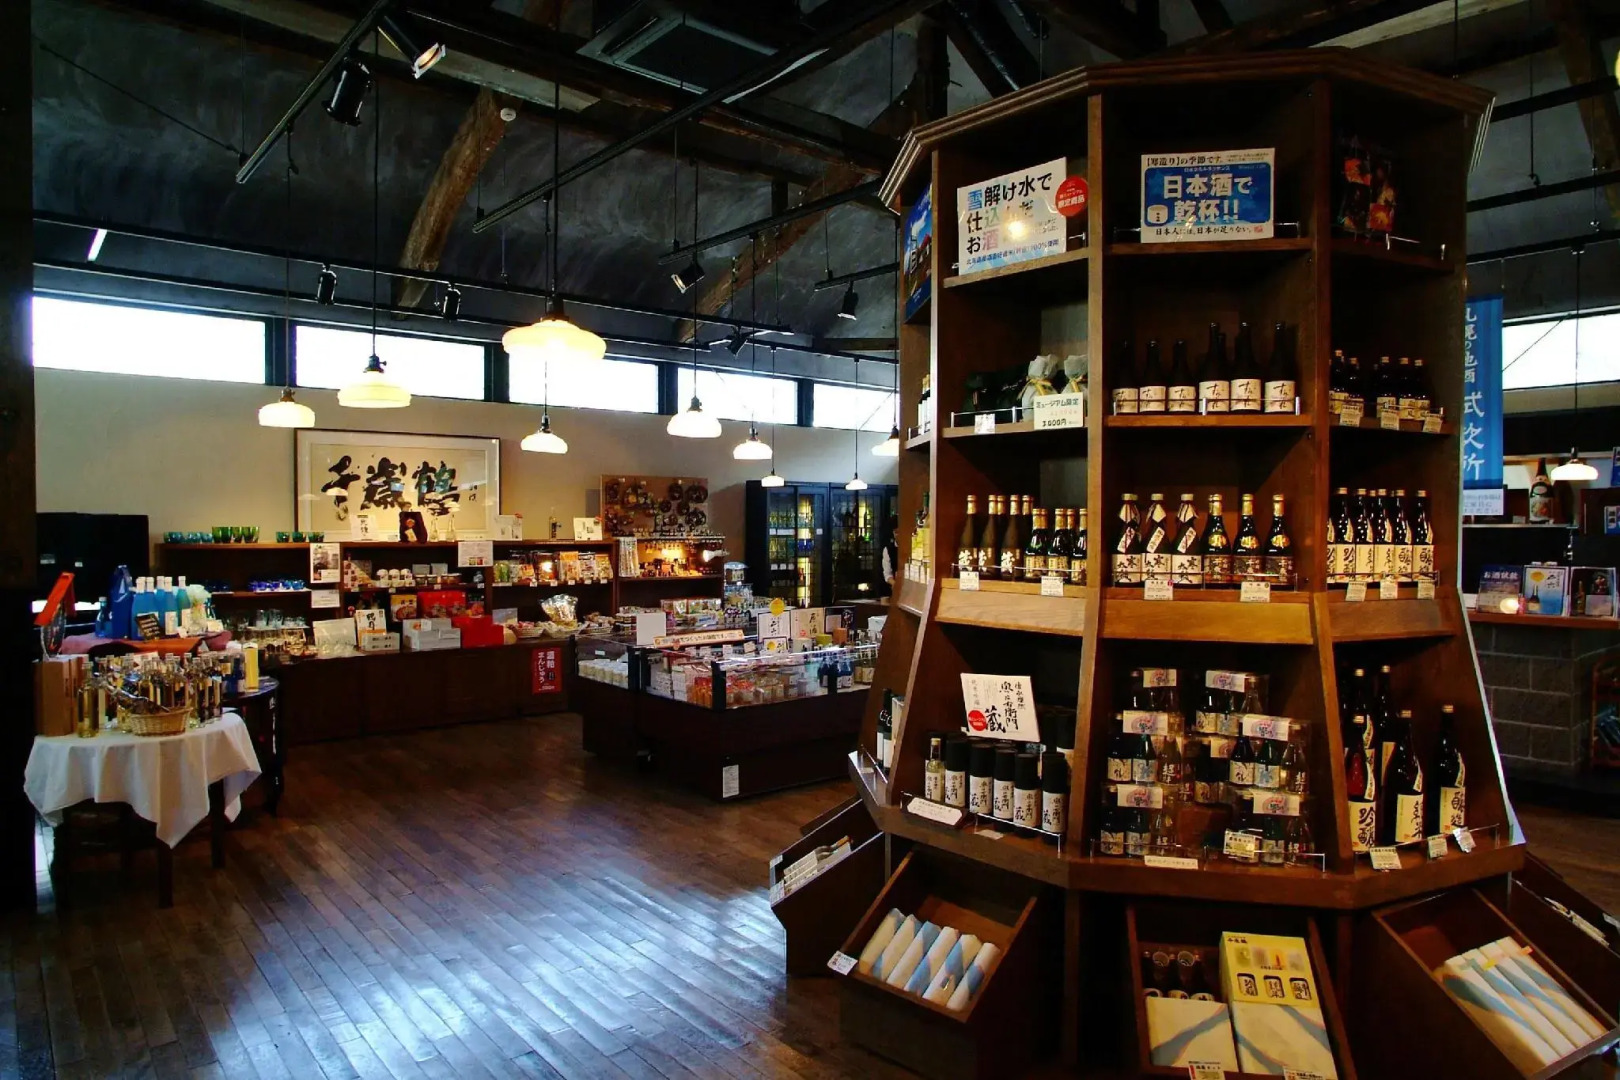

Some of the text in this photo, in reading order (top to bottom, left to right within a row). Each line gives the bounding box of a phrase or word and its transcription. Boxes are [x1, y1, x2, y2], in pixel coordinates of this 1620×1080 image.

[967, 172, 1053, 212] 雪解け水で
[1163, 173, 1252, 200] 日本酒で
[985, 705, 1006, 733] 蔵
